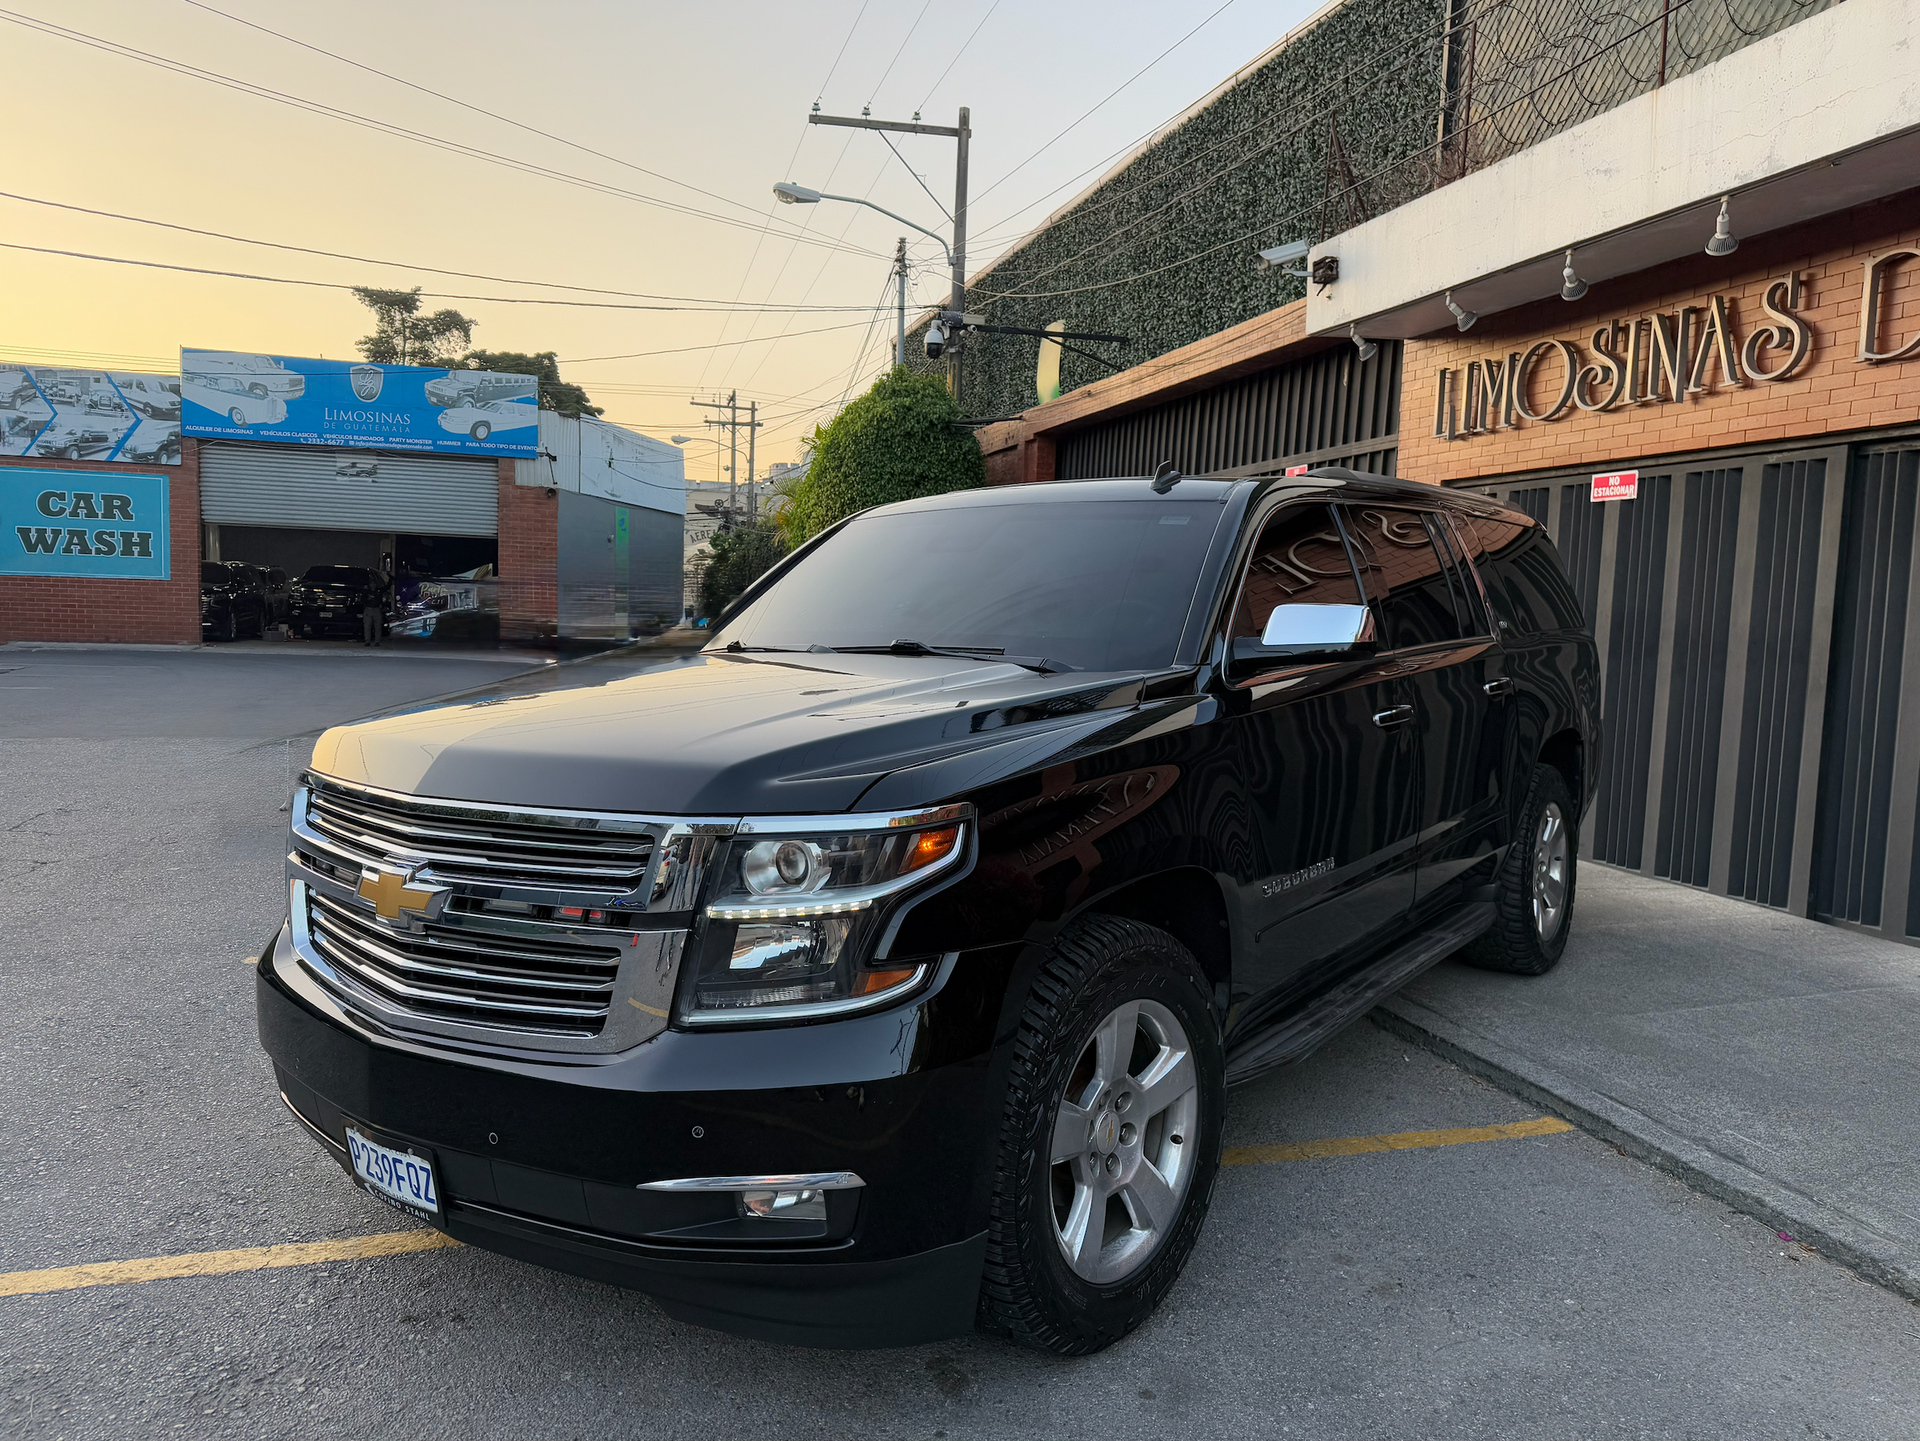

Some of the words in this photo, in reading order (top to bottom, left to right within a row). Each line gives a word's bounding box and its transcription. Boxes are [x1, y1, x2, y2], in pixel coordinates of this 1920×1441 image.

[1431, 271, 1813, 441] LIMOSINAS
[324, 407, 411, 425] LIMOSINAS
[324, 422, 336, 430] DE
[344, 423, 411, 434] GUATEMALA
[307, 438, 344, 446] 2332-6677
[1608, 476, 1620, 486] NO
[1594, 485, 1635, 497] ESTACIONAR
[36, 490, 135, 521] CAR
[15, 526, 153, 558] WASH
[1262, 856, 1336, 898] SUBURBAN
[348, 1135, 436, 1205] P239FQZ
[405, 1206, 431, 1221] STAHL
